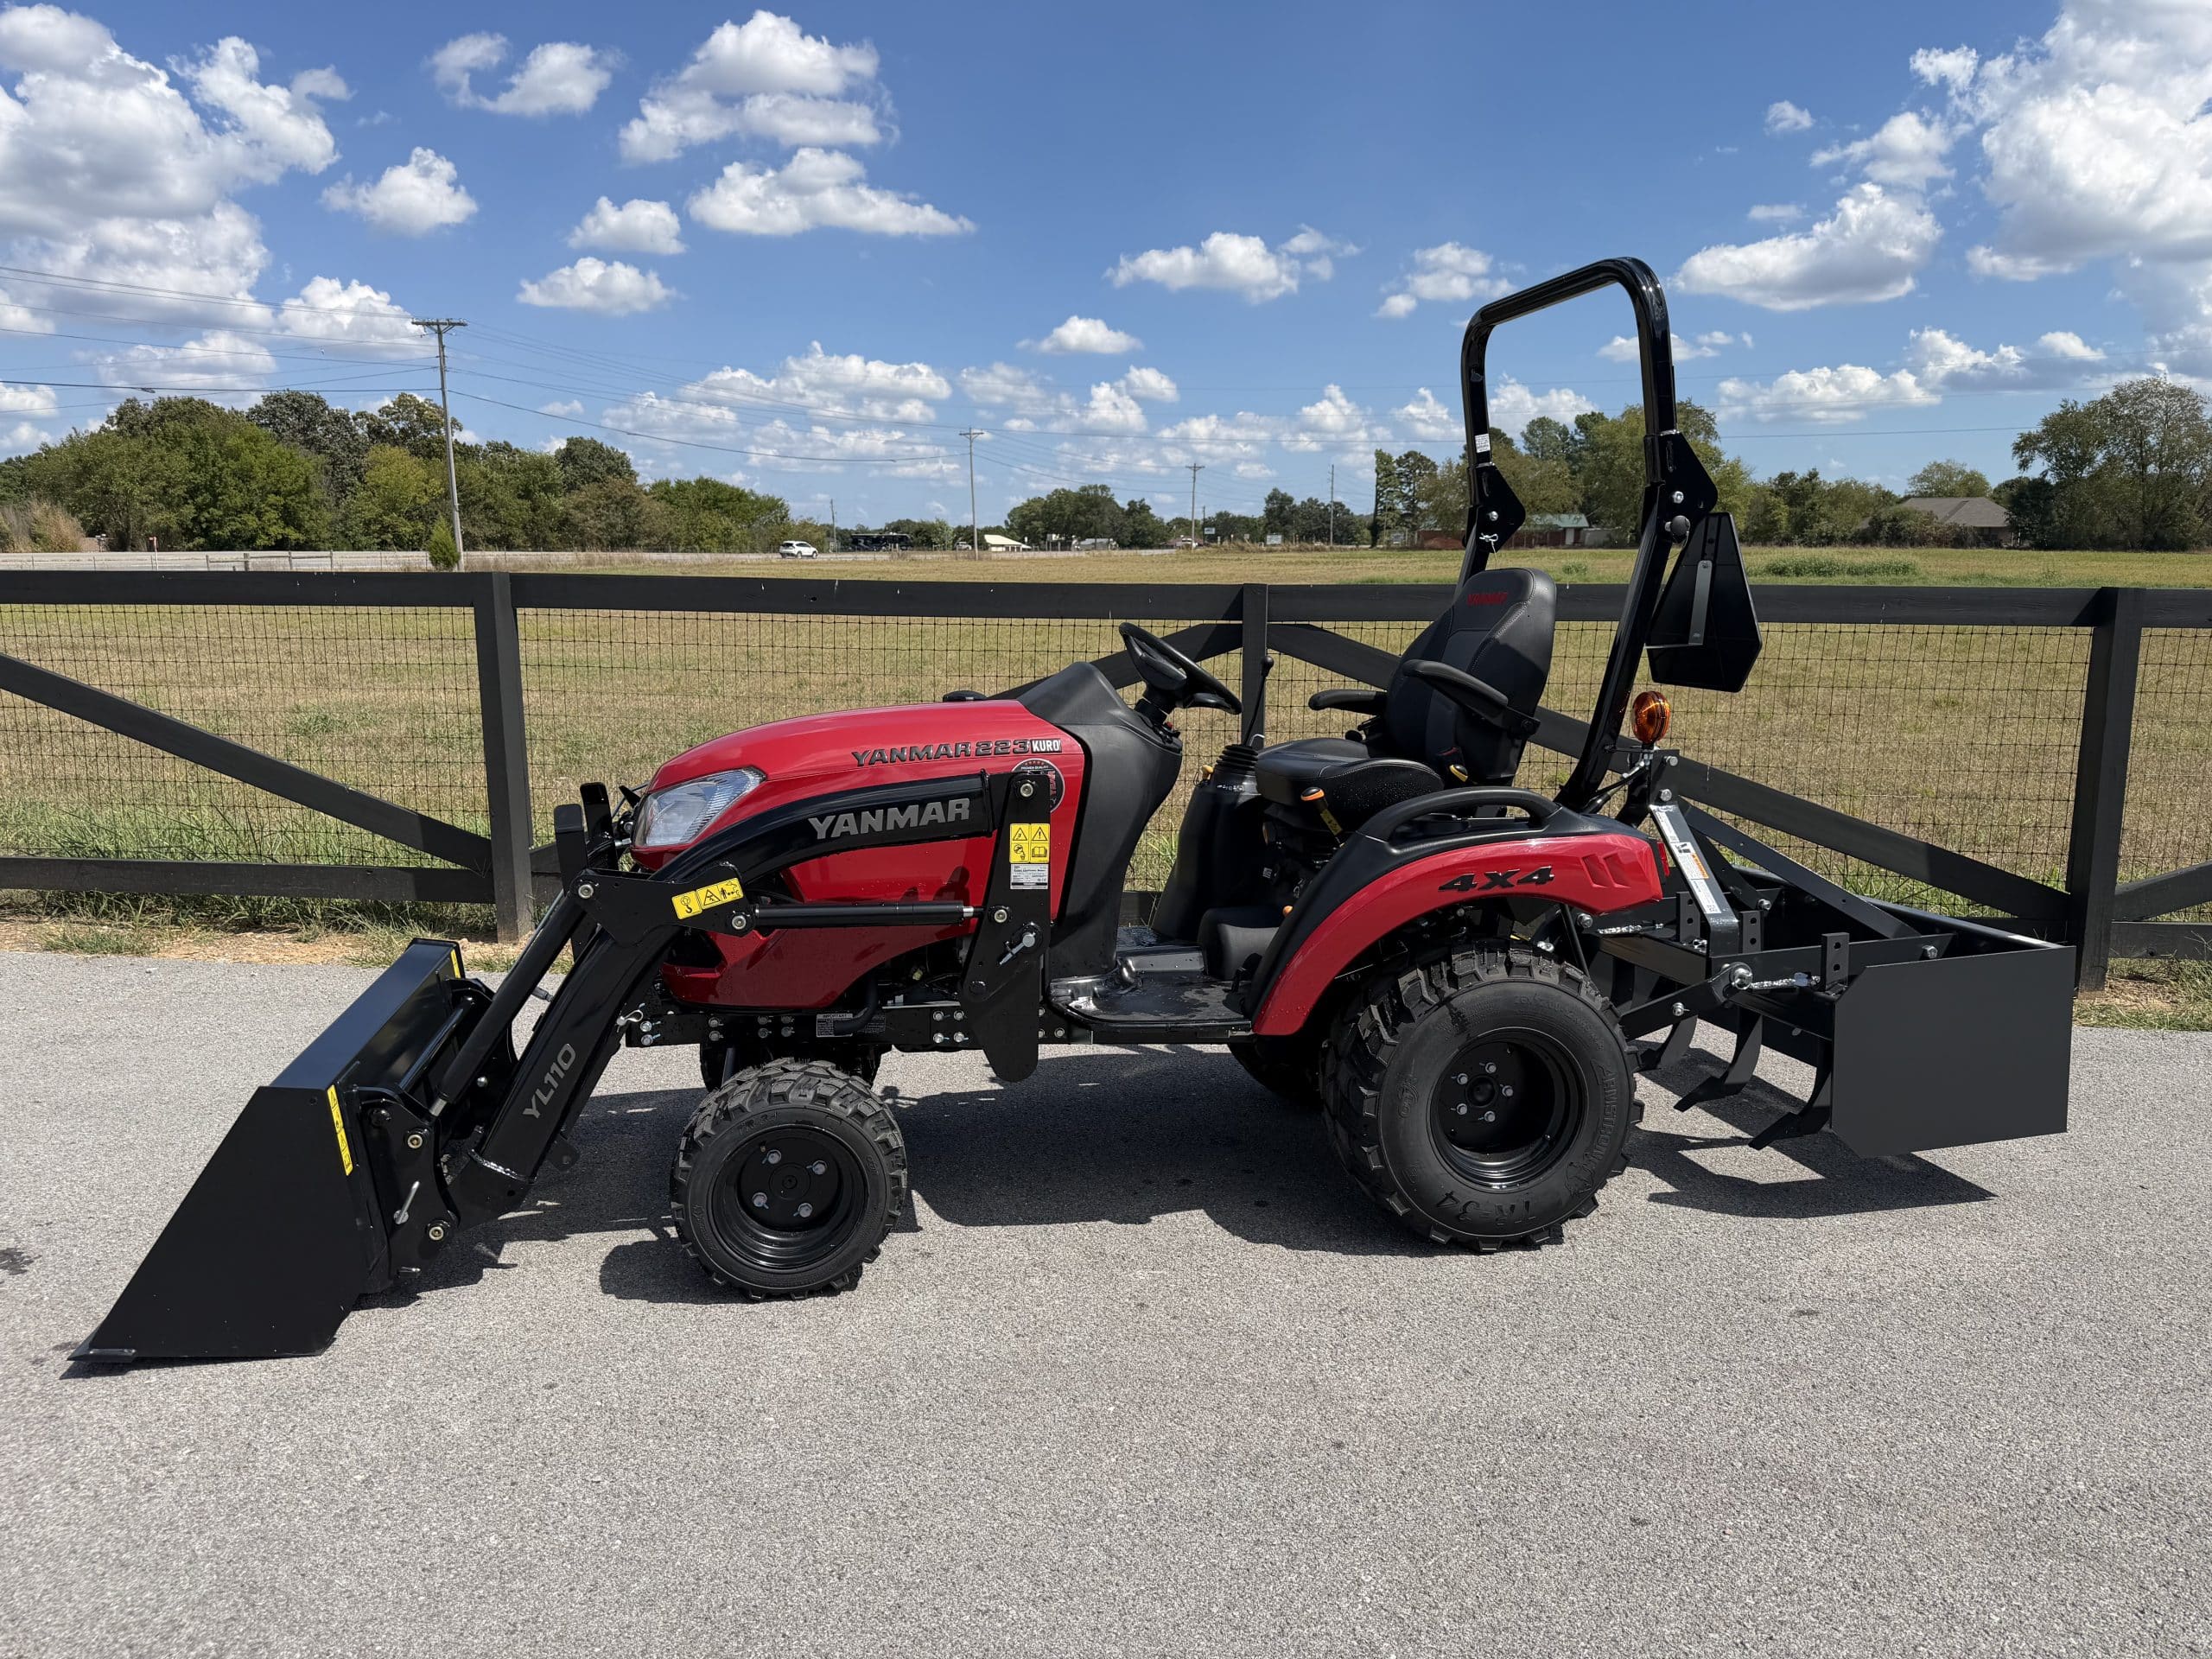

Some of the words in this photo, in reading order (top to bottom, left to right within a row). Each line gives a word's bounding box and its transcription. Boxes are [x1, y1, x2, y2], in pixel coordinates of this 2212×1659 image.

[852, 741, 971, 766] YANMAR
[975, 739, 1030, 756] 223
[1031, 740, 1060, 753] KURO
[807, 798, 970, 840] YANMAR
[1438, 865, 1555, 892] 4X4
[523, 1043, 576, 1119] YL110
